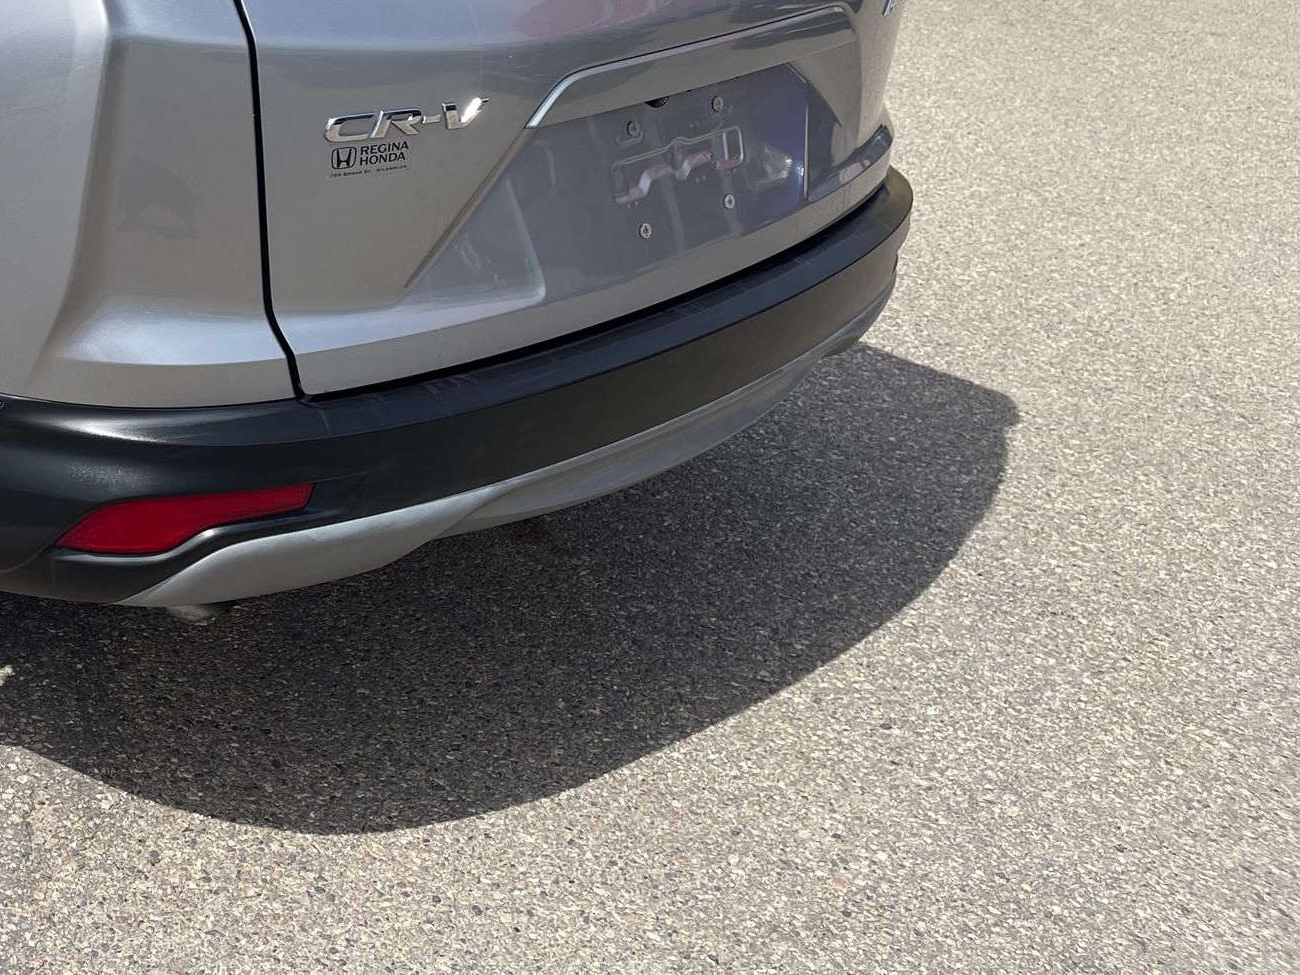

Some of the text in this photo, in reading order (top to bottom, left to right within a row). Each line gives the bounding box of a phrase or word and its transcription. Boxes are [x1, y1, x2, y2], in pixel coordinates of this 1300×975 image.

[324, 97, 490, 144] CR-V
[360, 140, 409, 156] REGINA
[360, 151, 406, 166] HONDA
